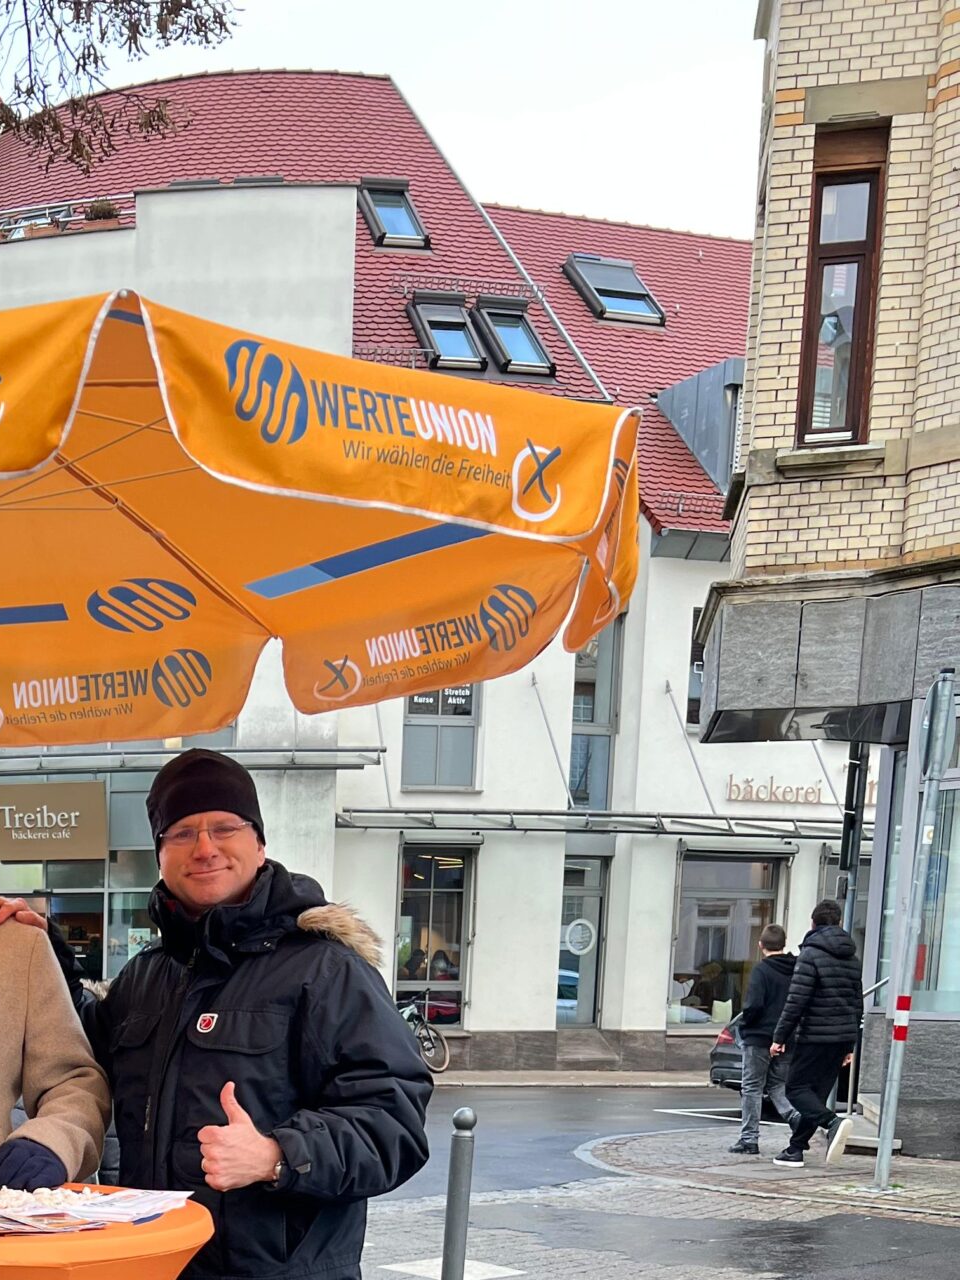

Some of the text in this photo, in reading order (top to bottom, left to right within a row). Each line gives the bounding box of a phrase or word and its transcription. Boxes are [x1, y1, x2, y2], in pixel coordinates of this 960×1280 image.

[310, 380, 497, 456] WERTEUNION
[343, 439, 511, 489] Wir wählen die Freiheit
[727, 773, 822, 804] bäckerei
[12, 829, 71, 840] bäckerei café
